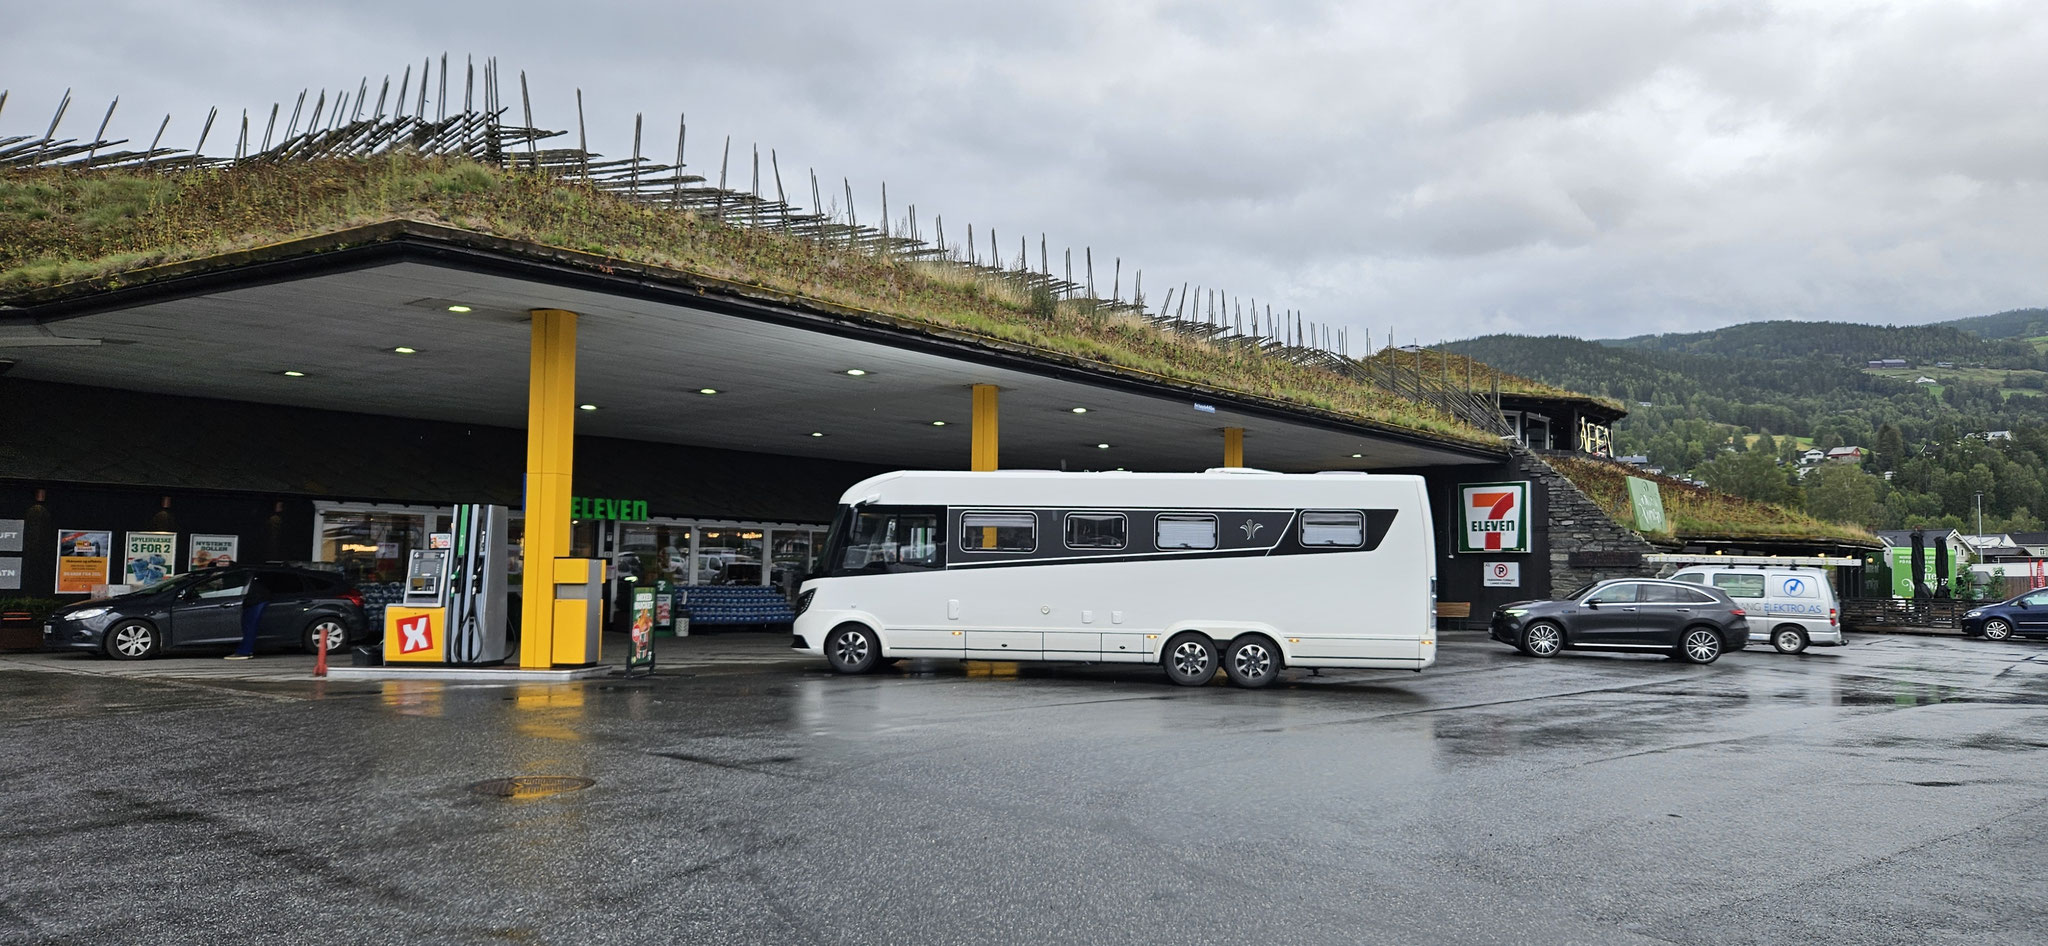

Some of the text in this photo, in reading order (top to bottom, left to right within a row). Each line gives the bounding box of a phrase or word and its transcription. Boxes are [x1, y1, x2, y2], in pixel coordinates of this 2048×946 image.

[1471, 491, 1514, 550] 7
[131, 543, 171, 554] 3 FOR 2
[1764, 603, 1806, 614] ELEKTRO
[1808, 604, 1823, 614] AS
